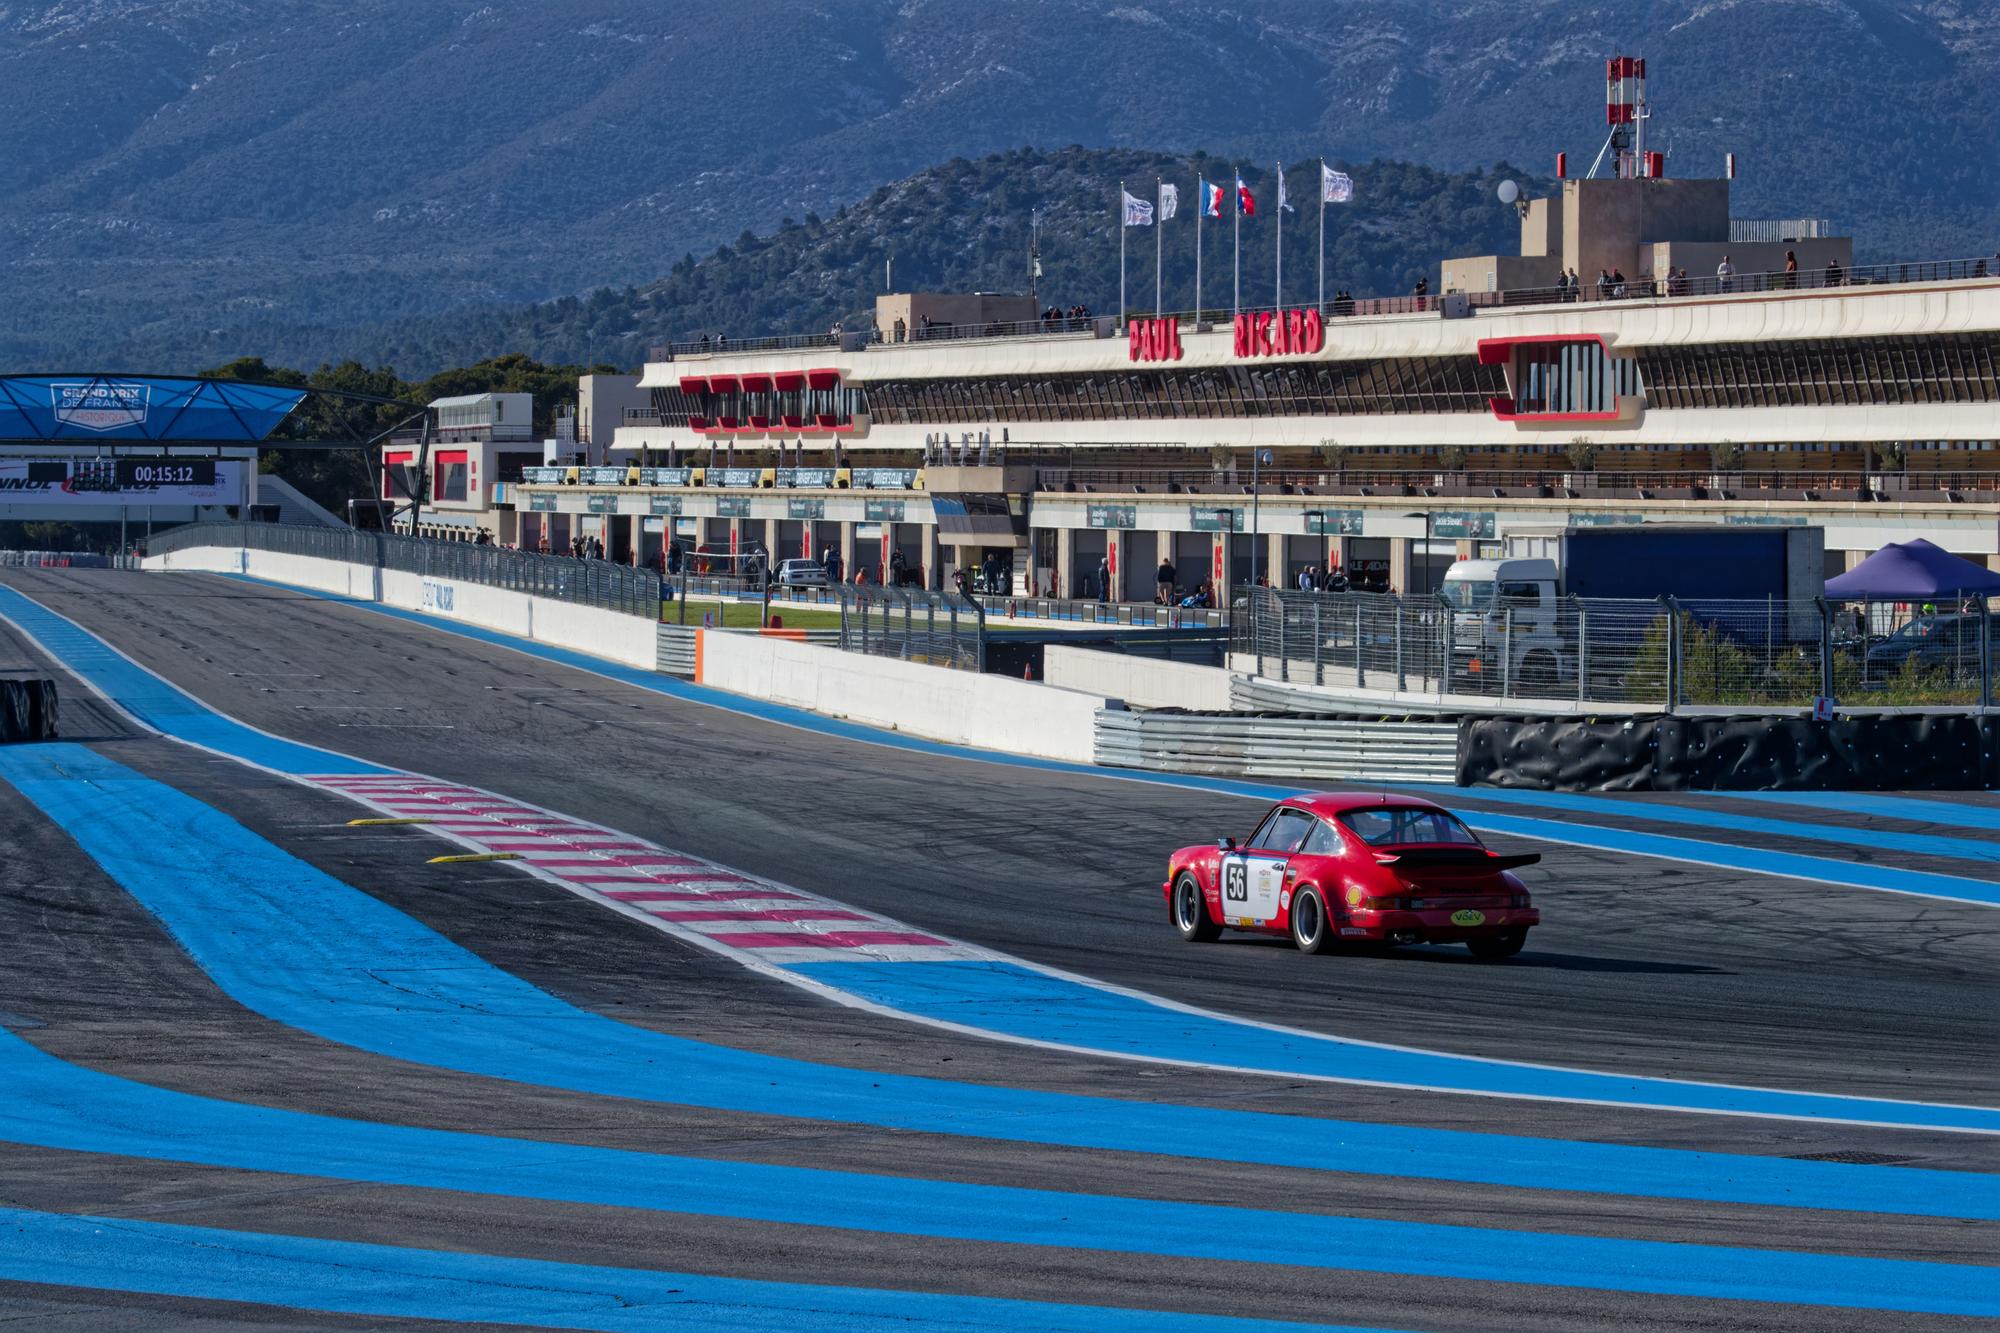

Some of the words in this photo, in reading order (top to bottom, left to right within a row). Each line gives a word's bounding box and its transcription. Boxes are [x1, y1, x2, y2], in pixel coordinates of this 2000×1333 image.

[1129, 317, 1182, 362] PAUL
[1234, 309, 1322, 358] RICARD
[62, 388, 108, 398] GRAND
[110, 388, 140, 398] PRIX
[62, 399, 79, 408] DE
[84, 399, 140, 408] FRANCE
[135, 466, 193, 482] 00:15:12
[1228, 867, 1245, 899] 56
